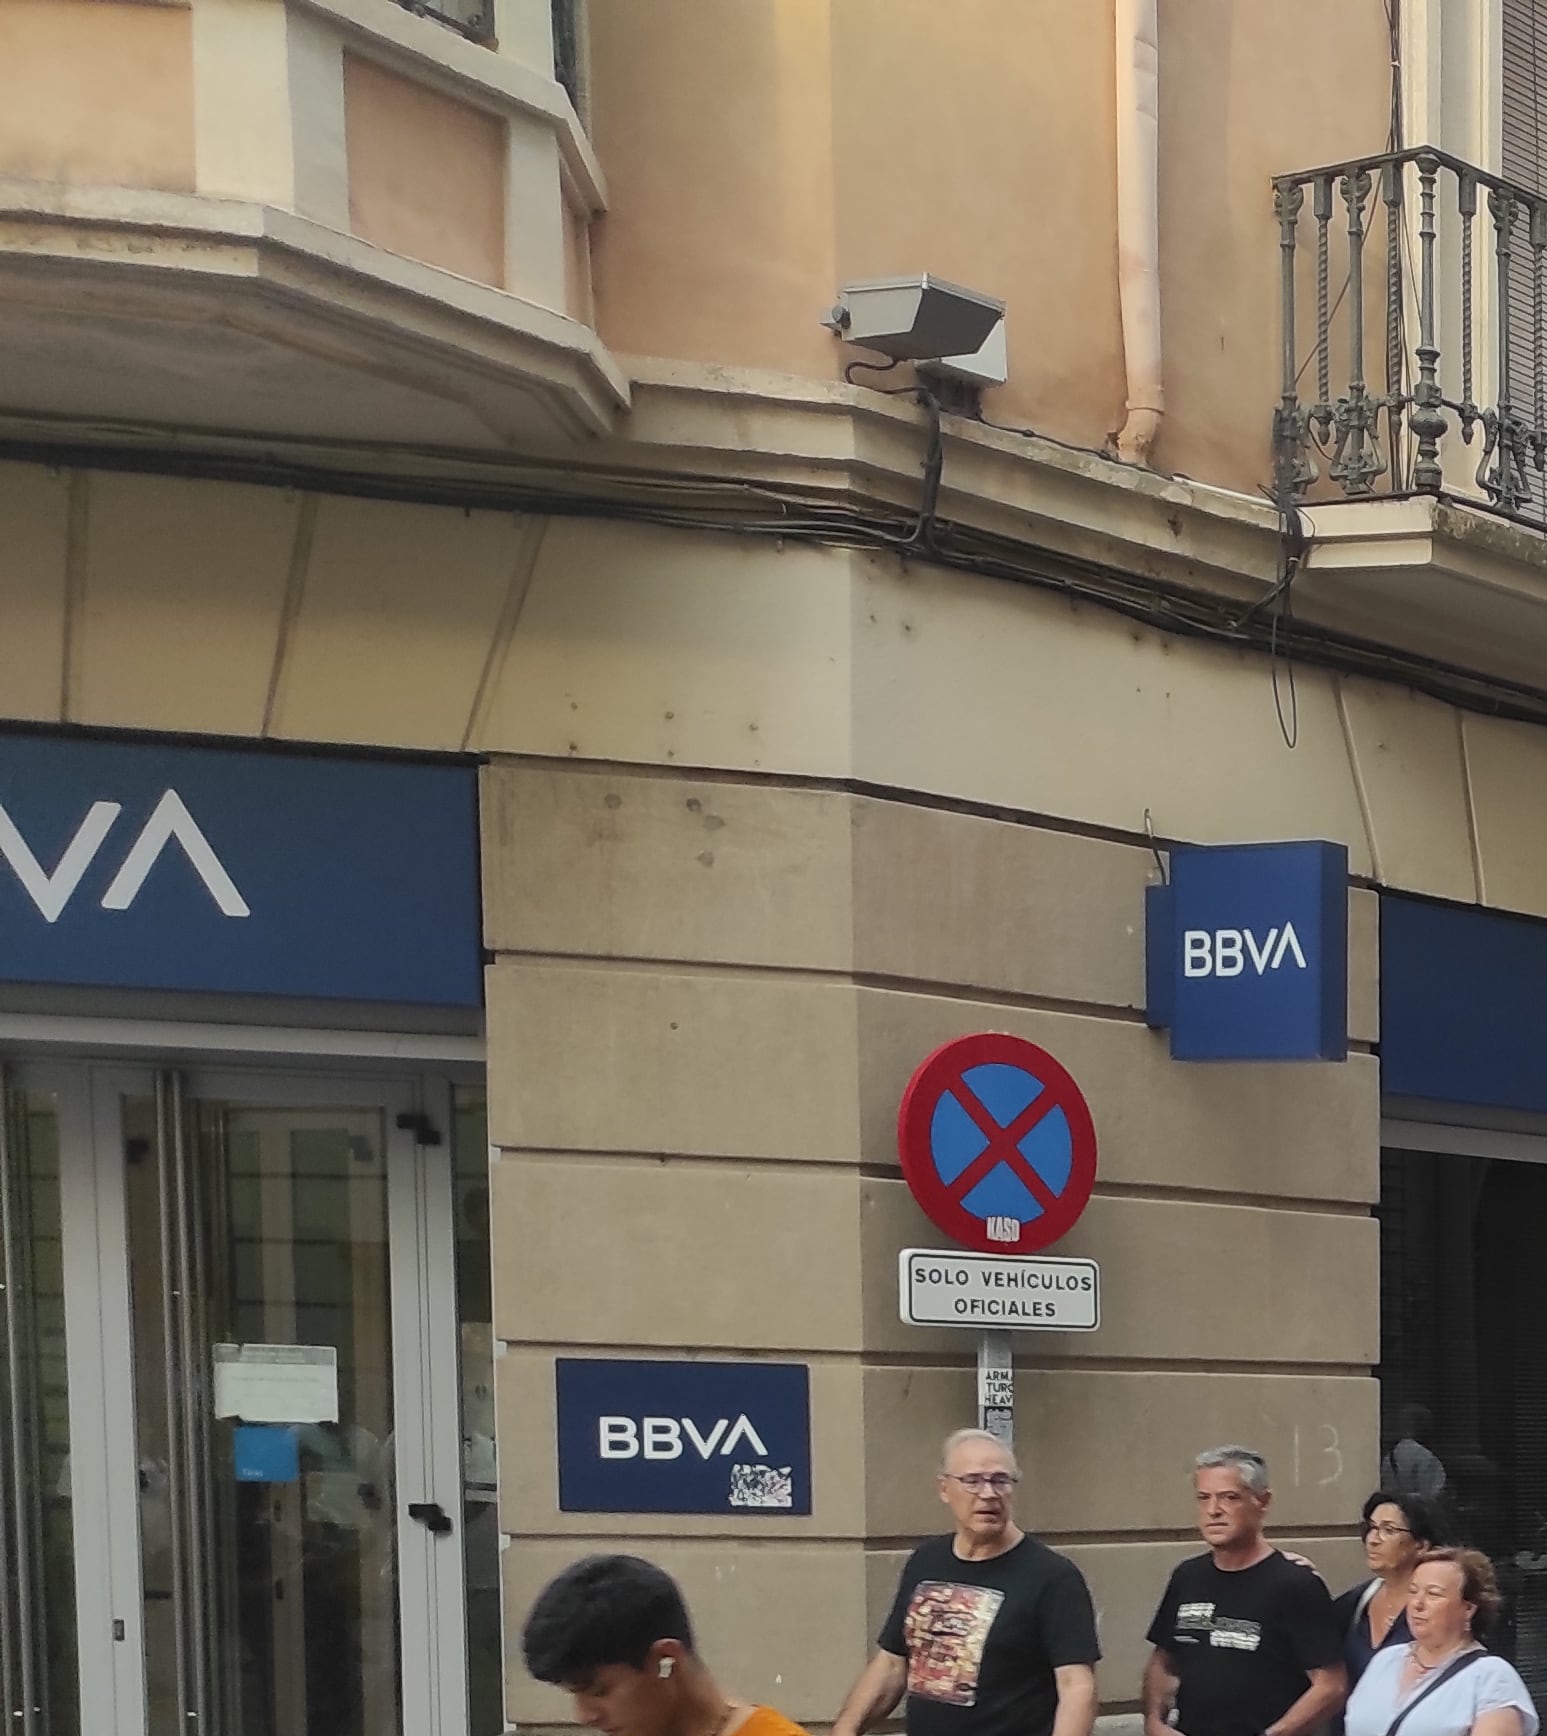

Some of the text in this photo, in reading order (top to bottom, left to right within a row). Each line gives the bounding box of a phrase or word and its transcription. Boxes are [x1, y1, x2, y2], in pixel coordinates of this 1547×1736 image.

[1183, 920, 1308, 978] BBVA
[914, 1267, 1093, 1292] SOLO VEHÍCULOS
[954, 1298, 1057, 1318] OFICIALES
[598, 1413, 769, 1460] BBVA
